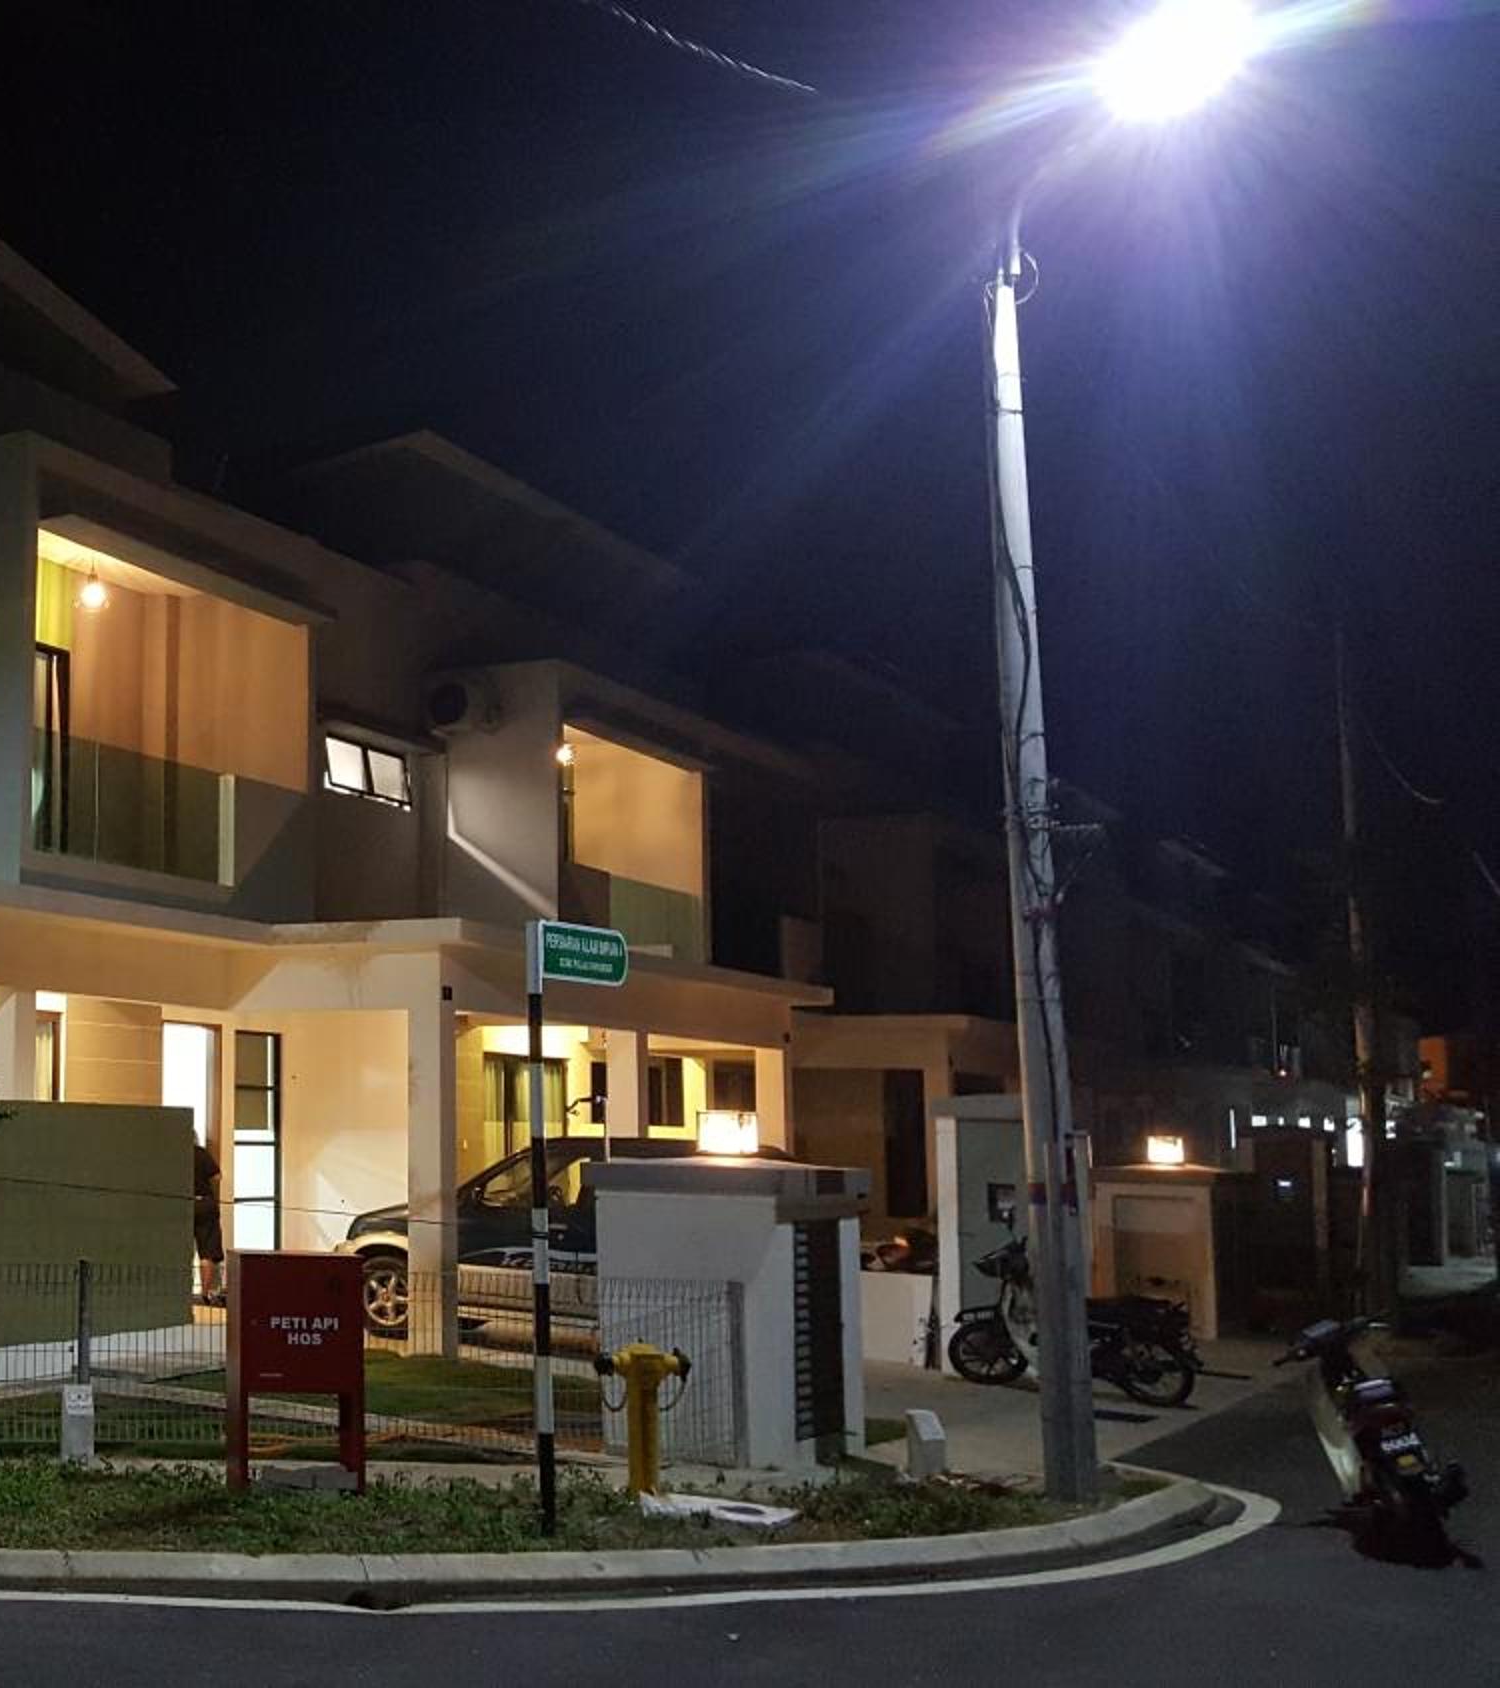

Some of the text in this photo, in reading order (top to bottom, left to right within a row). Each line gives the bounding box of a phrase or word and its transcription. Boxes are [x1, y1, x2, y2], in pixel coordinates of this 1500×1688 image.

[270, 1316, 339, 1330] PETI API
[287, 1332, 323, 1345] HOS
